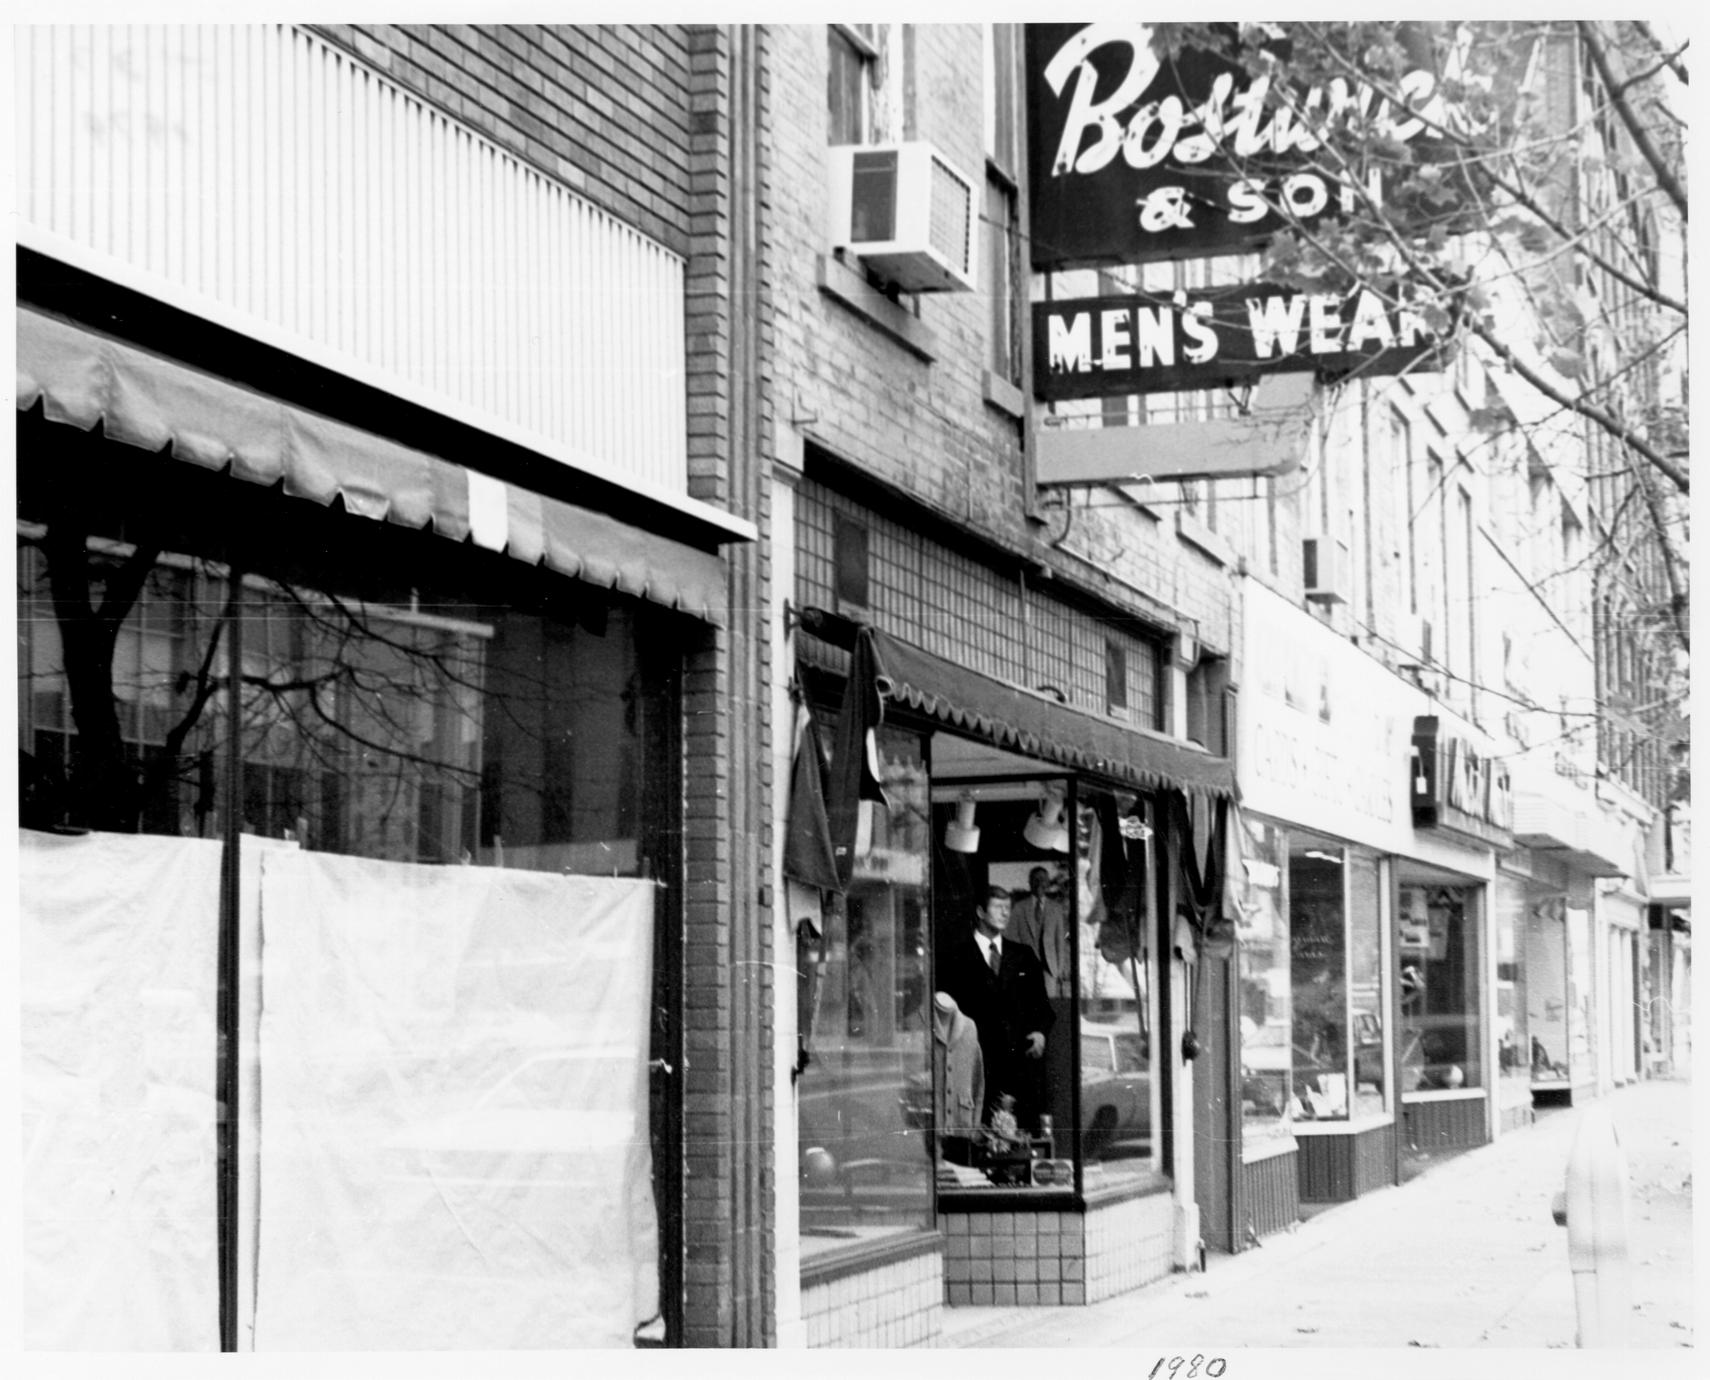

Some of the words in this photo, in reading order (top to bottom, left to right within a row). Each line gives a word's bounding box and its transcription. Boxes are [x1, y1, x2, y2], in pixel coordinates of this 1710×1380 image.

[1137, 186, 1196, 233] &
[1227, 167, 1383, 223] SON
[1048, 289, 1219, 375] MEN'S
[1147, 1353, 1228, 1380] 1980
